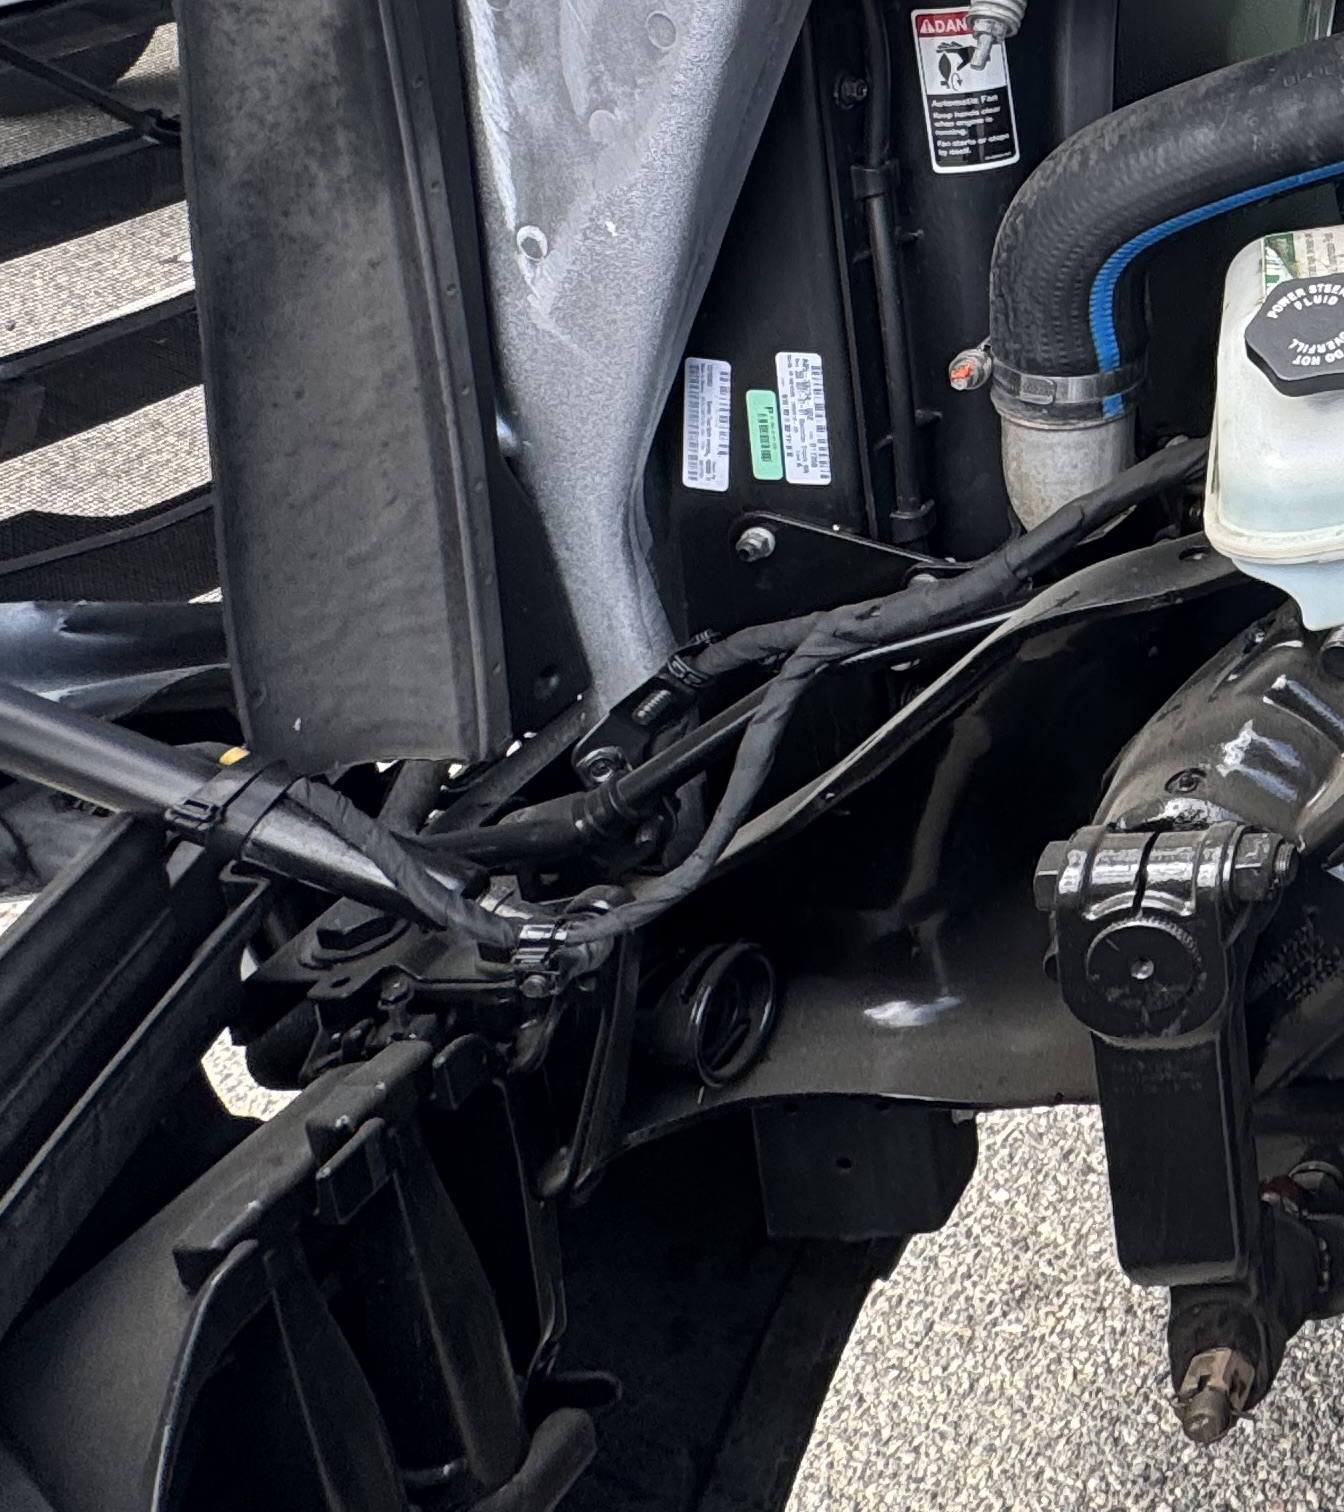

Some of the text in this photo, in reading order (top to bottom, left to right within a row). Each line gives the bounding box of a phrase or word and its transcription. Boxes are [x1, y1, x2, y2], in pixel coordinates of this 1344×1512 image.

[935, 19, 968, 34] DAN
[981, 95, 998, 105] Fan
[1266, 287, 1306, 319] POWER
[1293, 294, 1340, 311] FLUID
[1292, 355, 1321, 366] NOT
